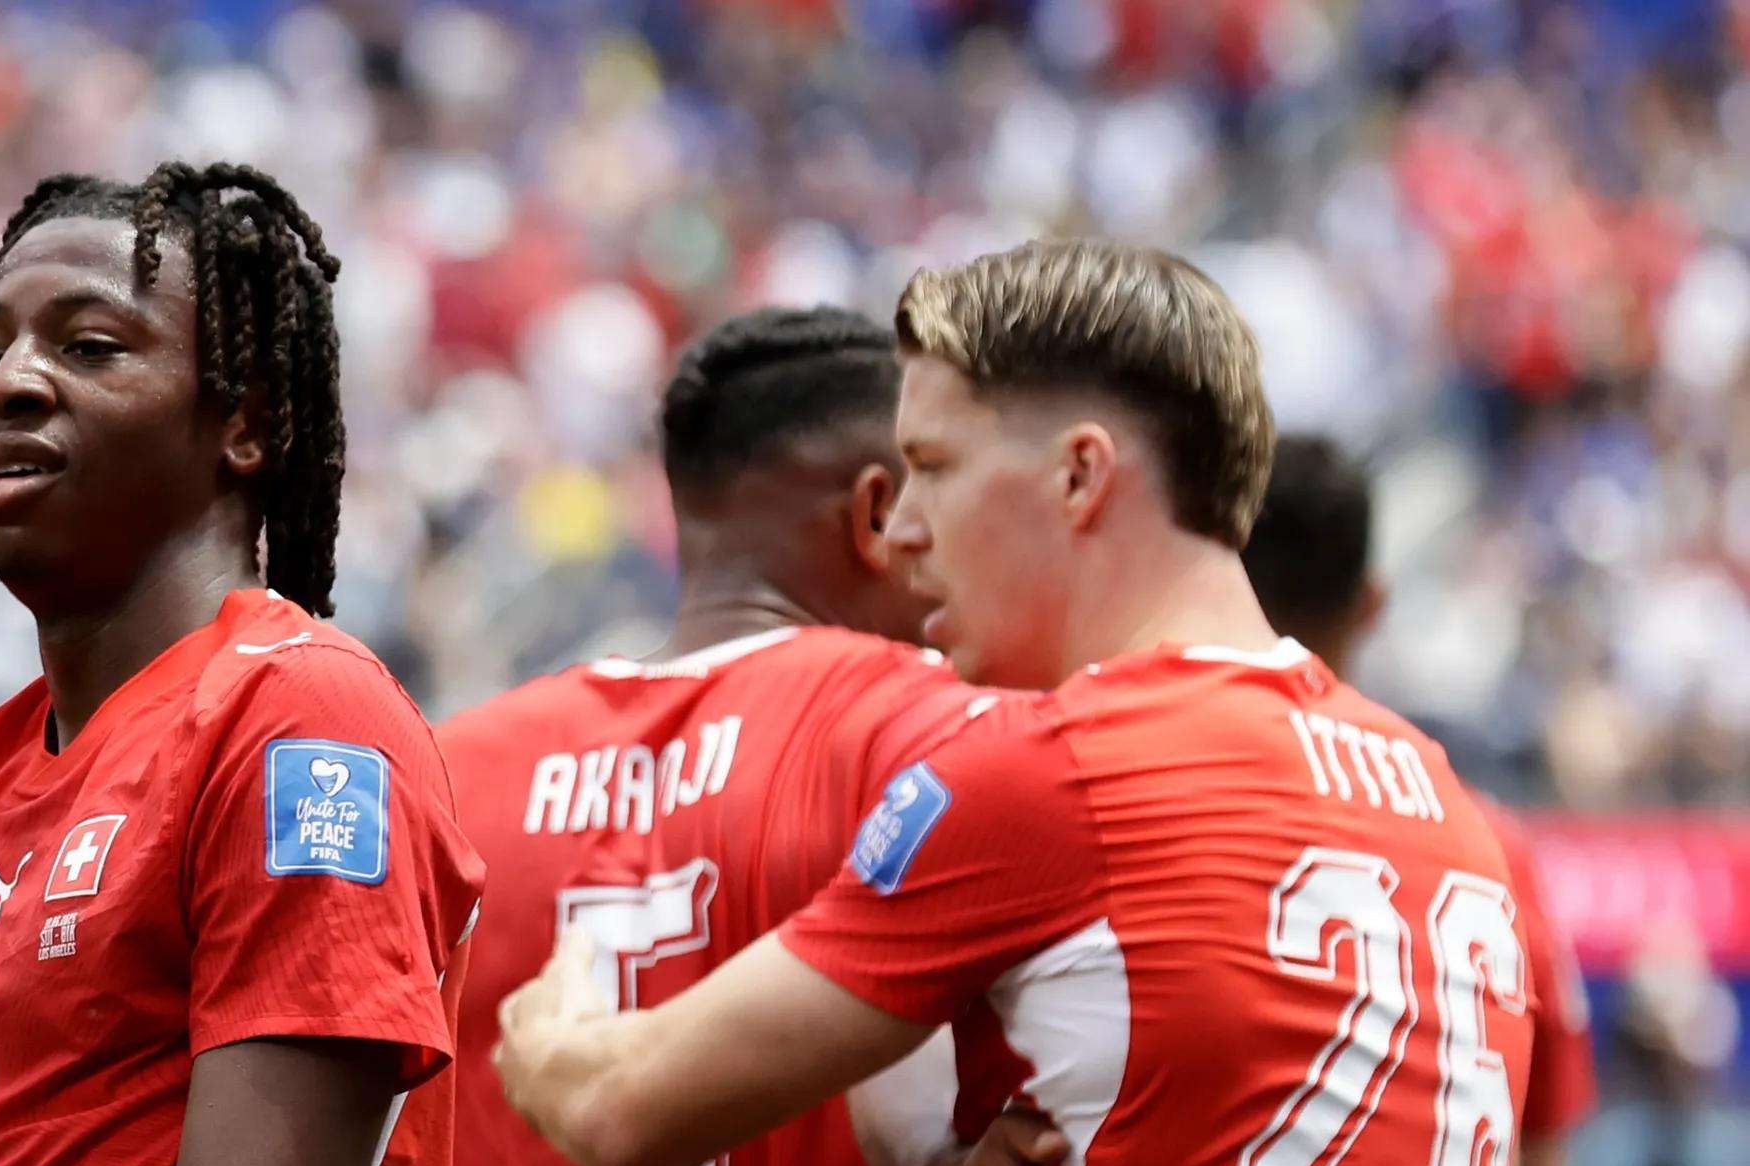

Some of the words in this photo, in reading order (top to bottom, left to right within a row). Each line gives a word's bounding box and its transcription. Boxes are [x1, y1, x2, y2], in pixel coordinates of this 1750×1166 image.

[523, 715, 742, 834] AKANJI
[1289, 709, 1445, 823] ITTEN
[296, 797, 336, 821] Unite
[337, 801, 360, 823] For
[299, 821, 355, 849] PEACE
[310, 847, 341, 861] FIFA
